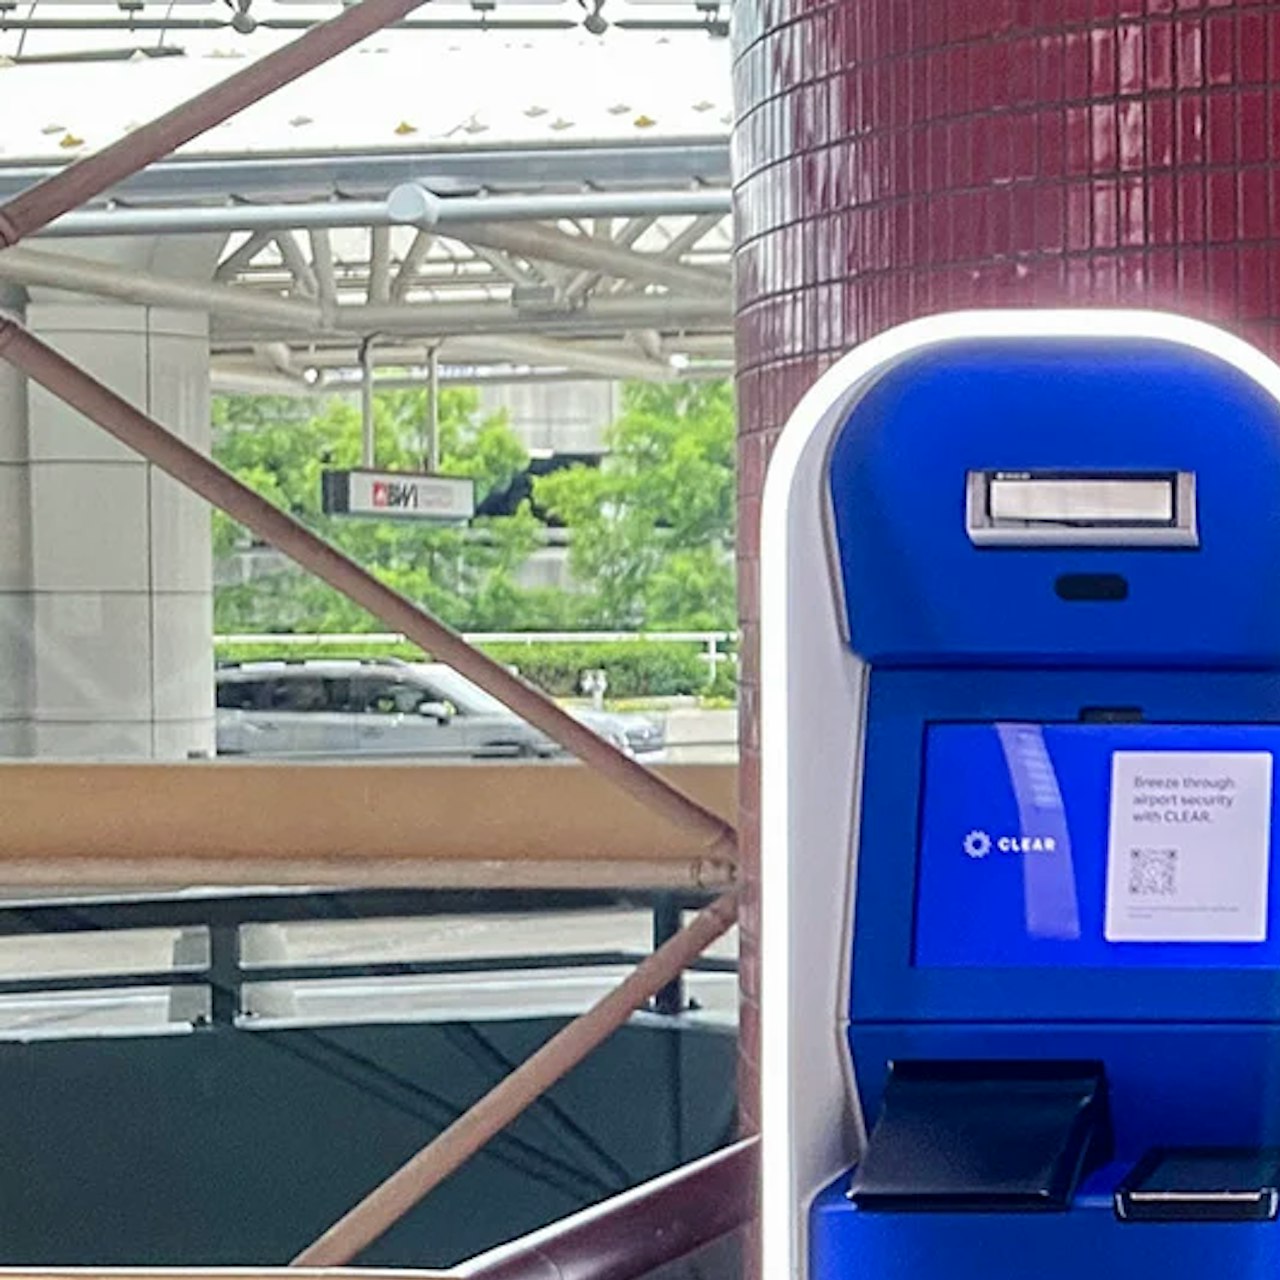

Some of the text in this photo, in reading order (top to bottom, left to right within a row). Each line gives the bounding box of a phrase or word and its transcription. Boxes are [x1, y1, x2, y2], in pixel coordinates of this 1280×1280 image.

[1133, 776, 1235, 791] Breeze through
[1132, 794, 1234, 808] airport security
[1132, 811, 1162, 823] with
[996, 836, 1056, 852] CLEAR
